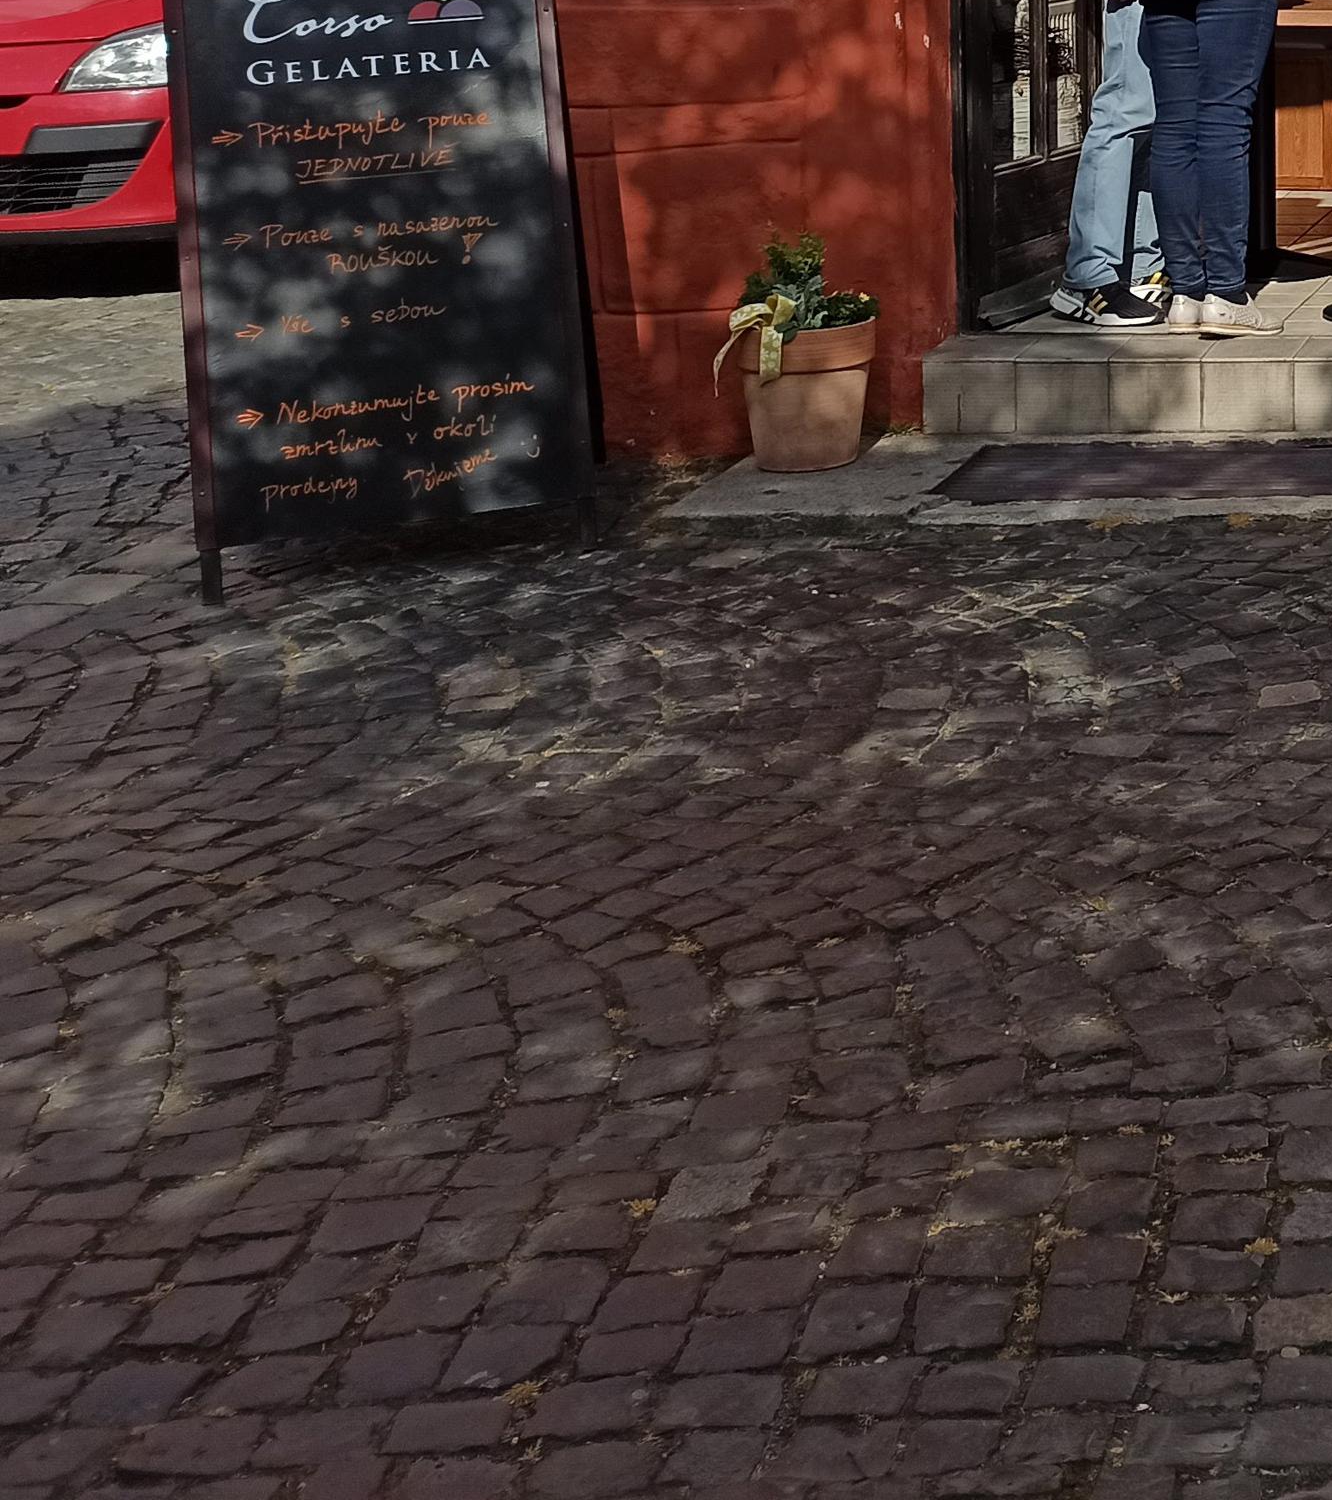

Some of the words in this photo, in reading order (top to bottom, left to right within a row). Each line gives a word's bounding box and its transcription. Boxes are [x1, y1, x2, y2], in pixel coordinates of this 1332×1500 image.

[246, 48, 490, 86] GELATERIA
[417, 112, 493, 148] pouze
[260, 224, 333, 249] Pouze
[353, 224, 364, 238] s
[377, 214, 499, 238] nasazenou
[341, 315, 351, 329] s
[371, 297, 448, 323] sebou
[277, 384, 440, 425] Nekonzumujte
[452, 373, 535, 412] prosím
[280, 428, 384, 460] zmrzlinu
[433, 414, 498, 440] okolí
[260, 473, 359, 513] prodejny
